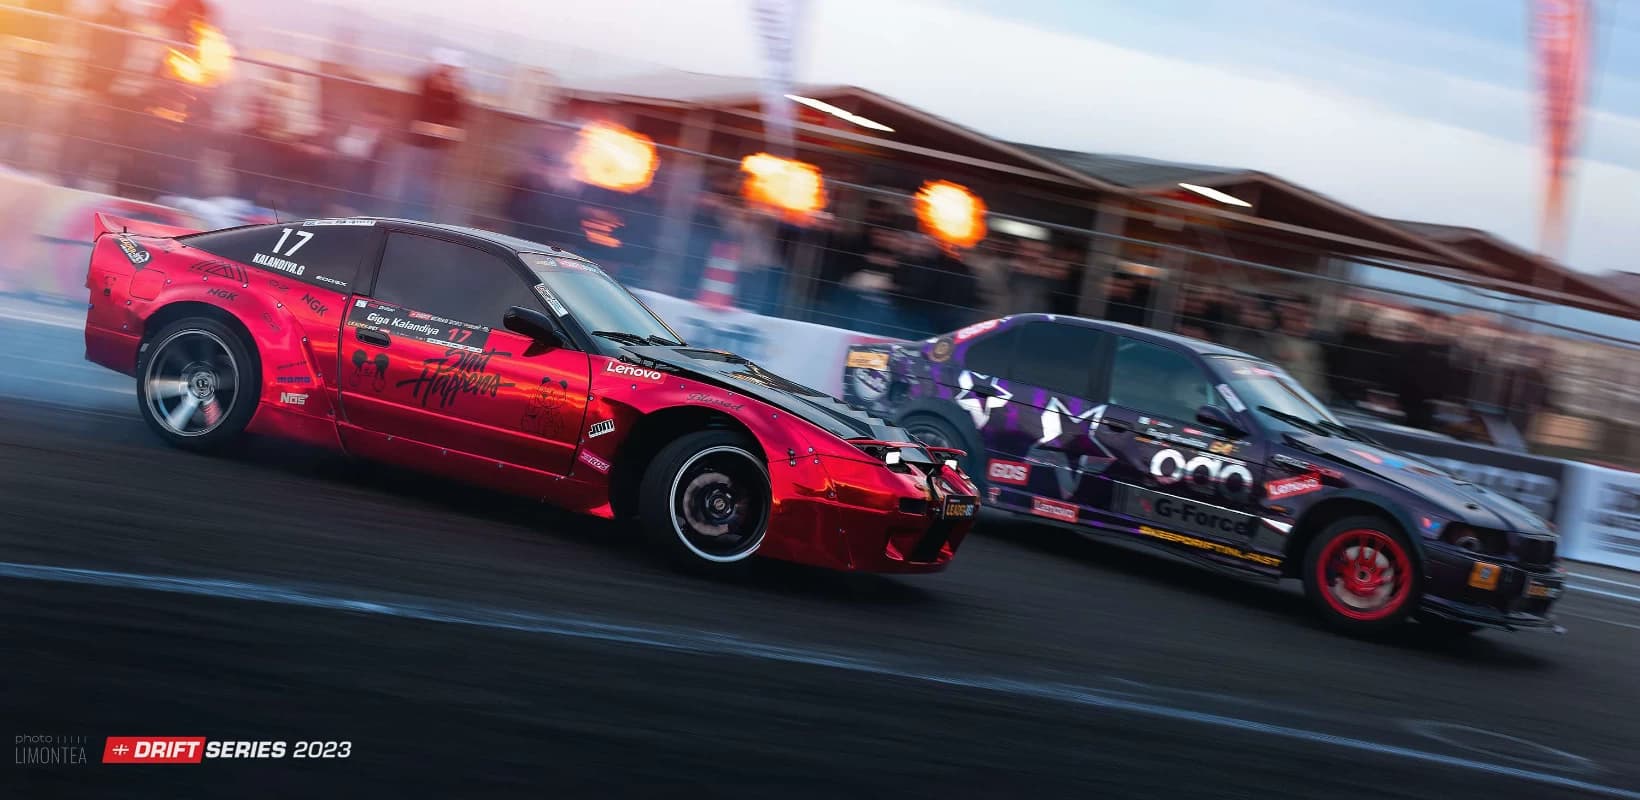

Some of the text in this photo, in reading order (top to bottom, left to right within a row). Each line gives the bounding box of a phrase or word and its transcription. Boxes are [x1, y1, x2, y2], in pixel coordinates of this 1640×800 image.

[272, 228, 314, 256] 17
[252, 253, 305, 275] KALANDIYA.G
[207, 287, 238, 301] NGK
[302, 293, 328, 317] NGK
[367, 312, 439, 335] Giga Kalandiya
[448, 327, 472, 343] 17
[606, 361, 662, 380] Lenovo
[1155, 498, 1249, 537] G-Force
